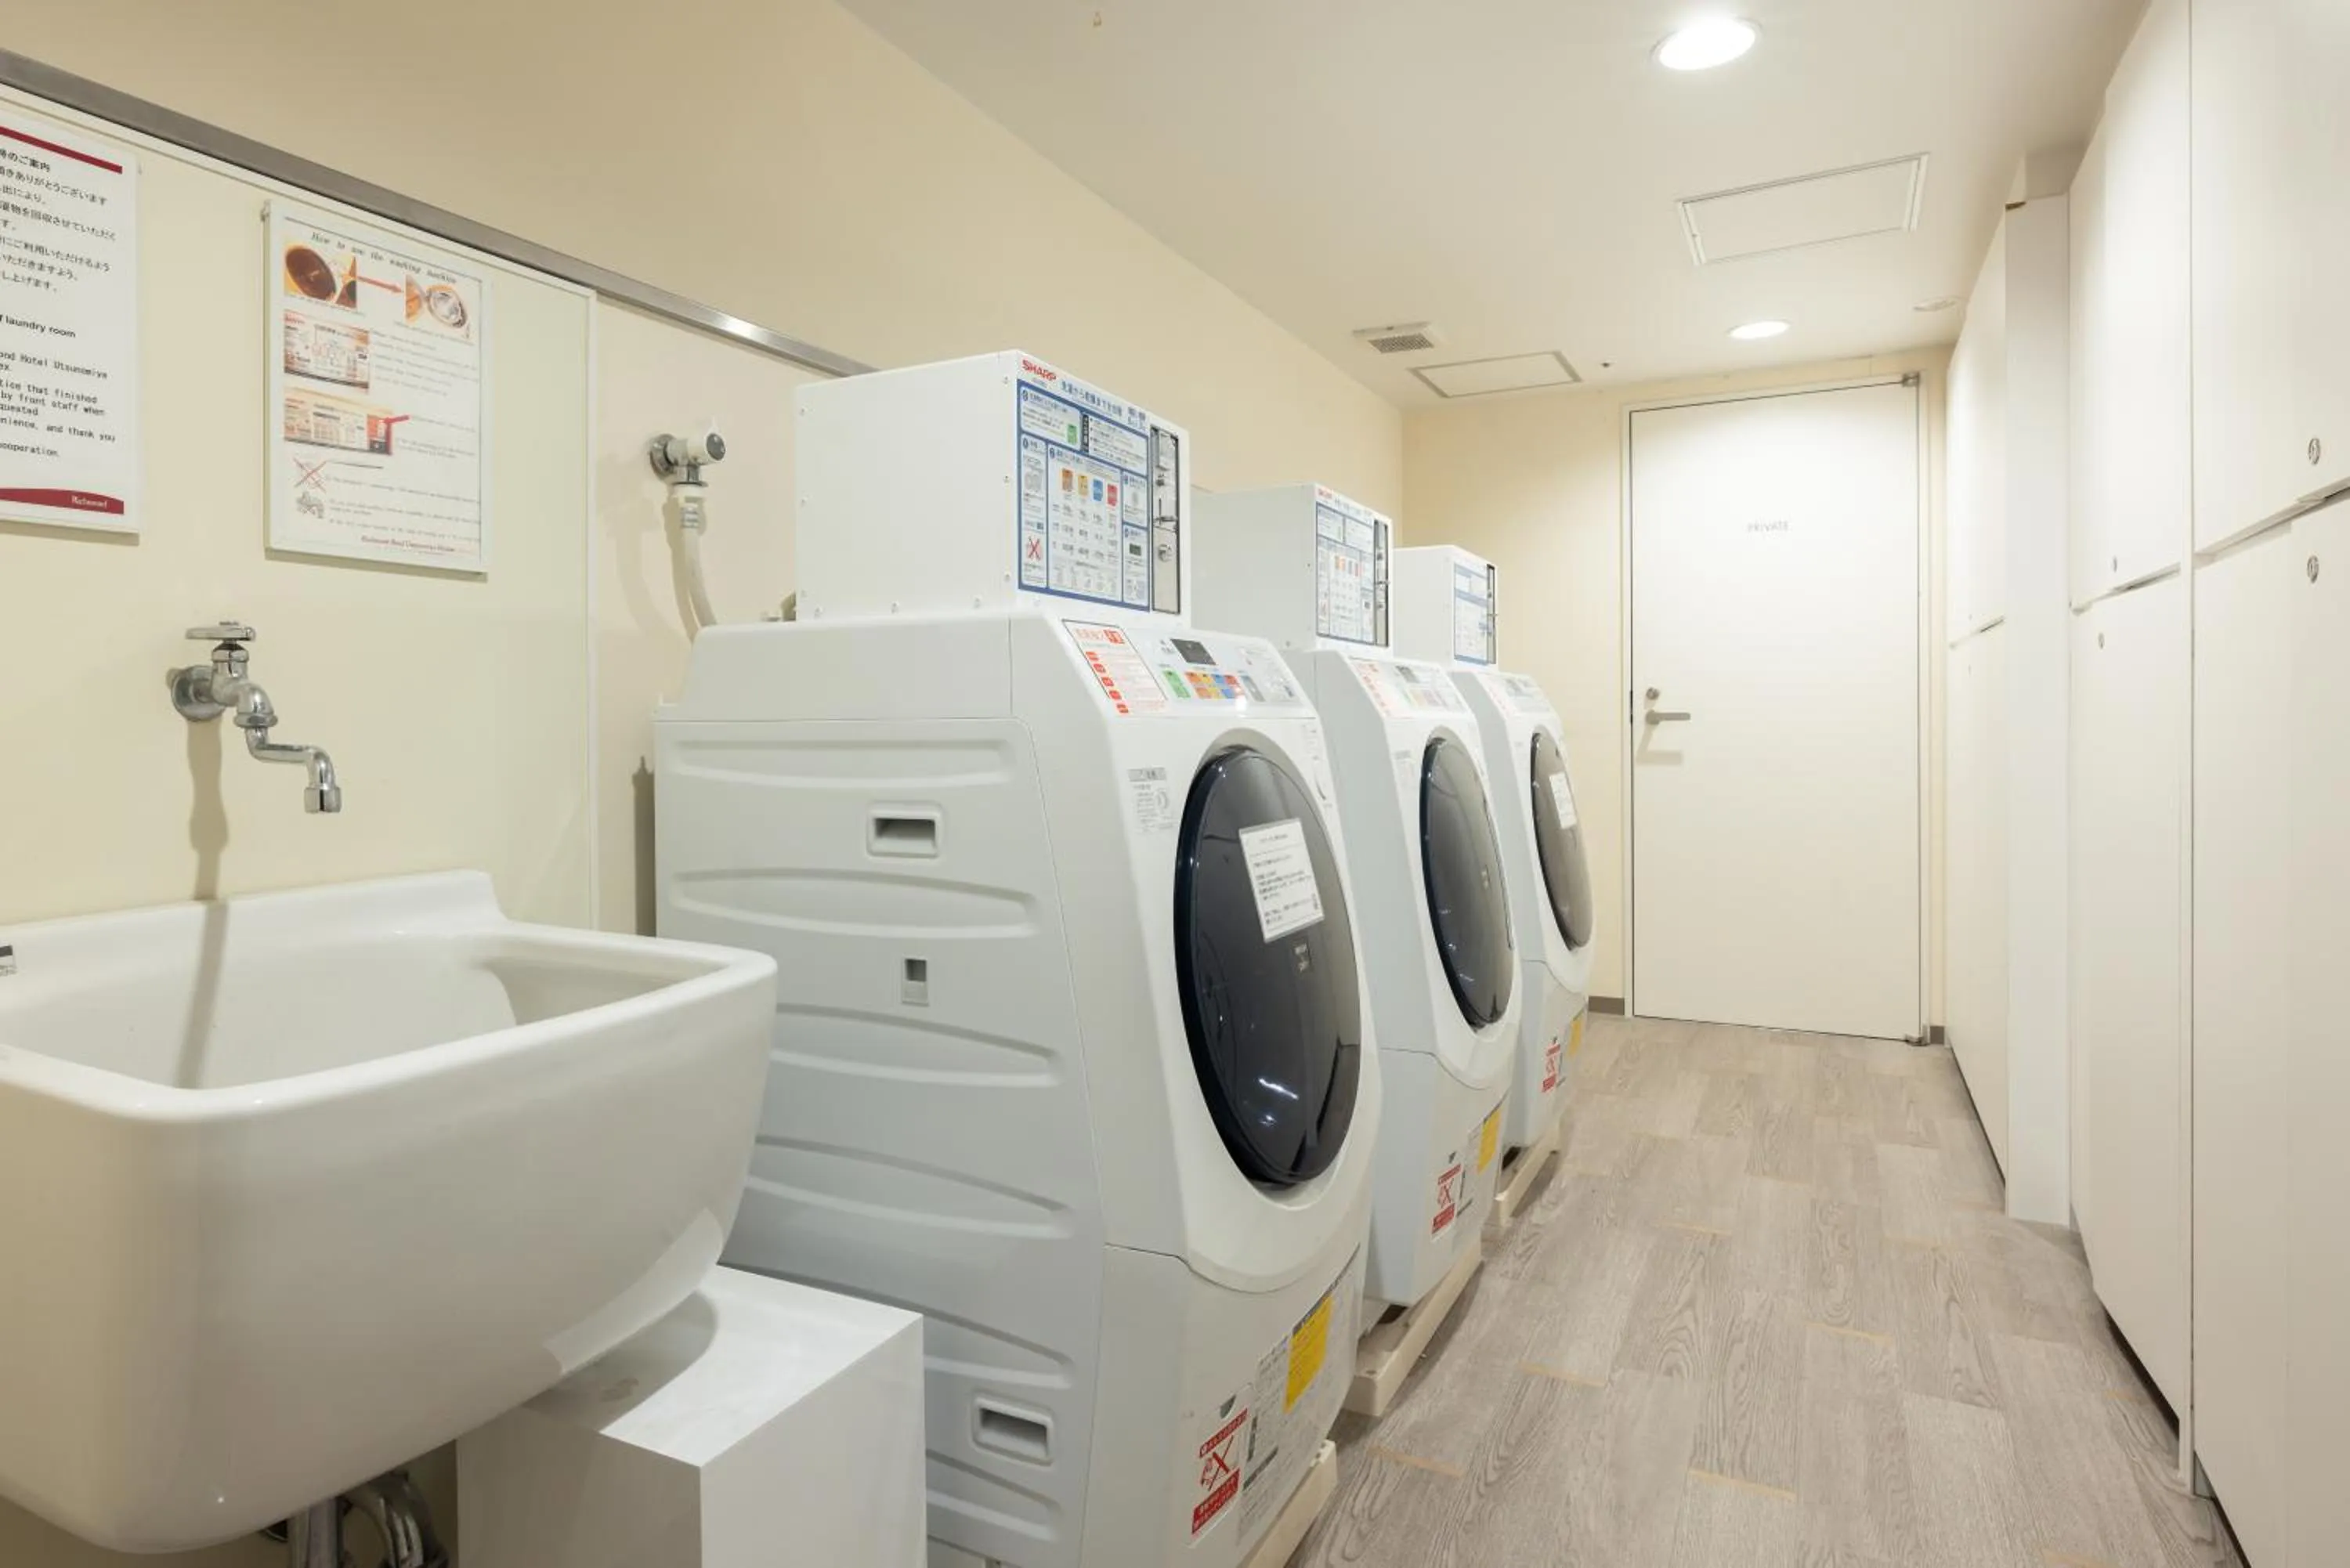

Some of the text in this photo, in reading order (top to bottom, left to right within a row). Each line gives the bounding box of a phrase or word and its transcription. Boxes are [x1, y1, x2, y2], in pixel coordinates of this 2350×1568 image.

[0, 184, 46, 205] 出により、
[0, 235, 110, 273] にご利用いただけるよう
[5, 315, 45, 333] laundry
[49, 326, 76, 338] room
[20, 353, 48, 367] Hotel
[54, 362, 107, 379] Utsunomiya
[1022, 359, 1057, 381] SHARP
[1, 390, 13, 401] by
[20, 393, 45, 406] front
[52, 400, 78, 411] staff
[27, 384, 49, 395] that
[55, 388, 98, 403] finished
[46, 425, 63, 433] and
[68, 427, 95, 439] thank
[99, 434, 116, 443] you
